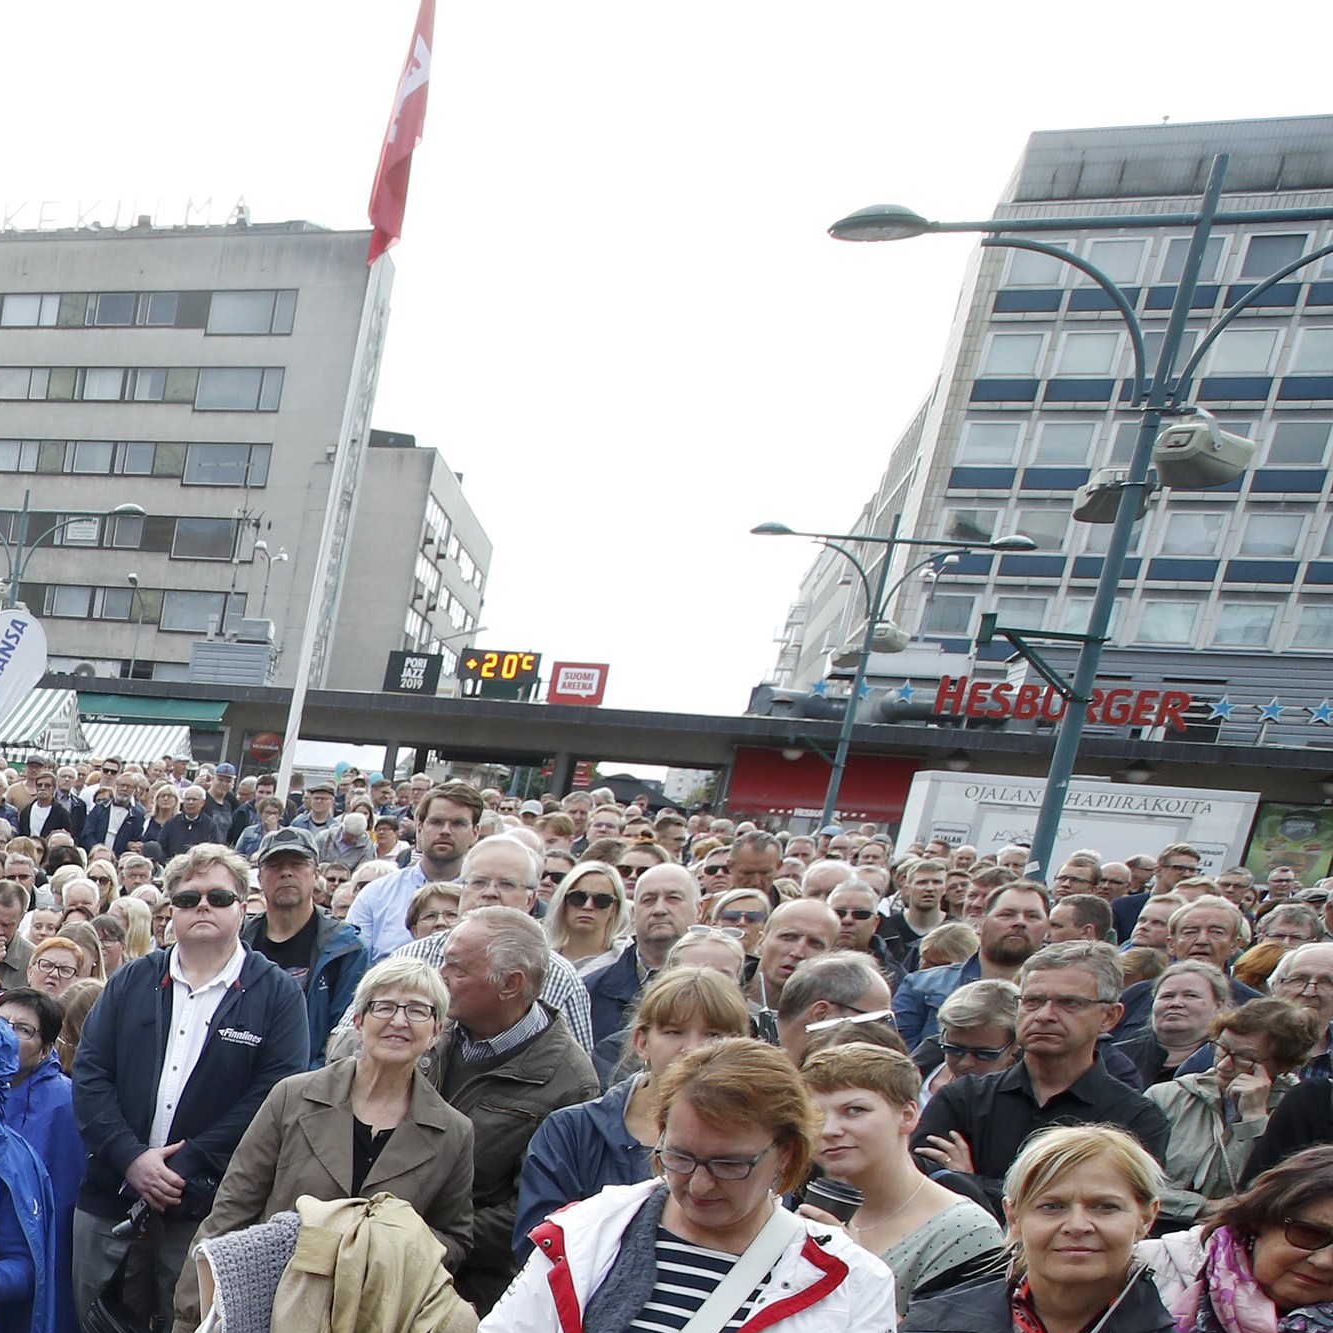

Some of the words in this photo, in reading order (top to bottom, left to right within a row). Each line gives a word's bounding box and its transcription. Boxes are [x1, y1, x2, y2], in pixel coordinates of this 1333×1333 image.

[404, 656, 428, 669] PORI
[400, 667, 425, 679] JAZZ
[563, 672, 595, 682] SUOMI
[399, 678, 424, 689] 2019
[560, 681, 593, 691] AREENA
[933, 675, 1191, 732] HESBURGER
[964, 785, 1042, 803] OJALAN
[1064, 793, 1213, 814] HAPIIRAKOITA
[223, 1027, 263, 1043] Finnlines
